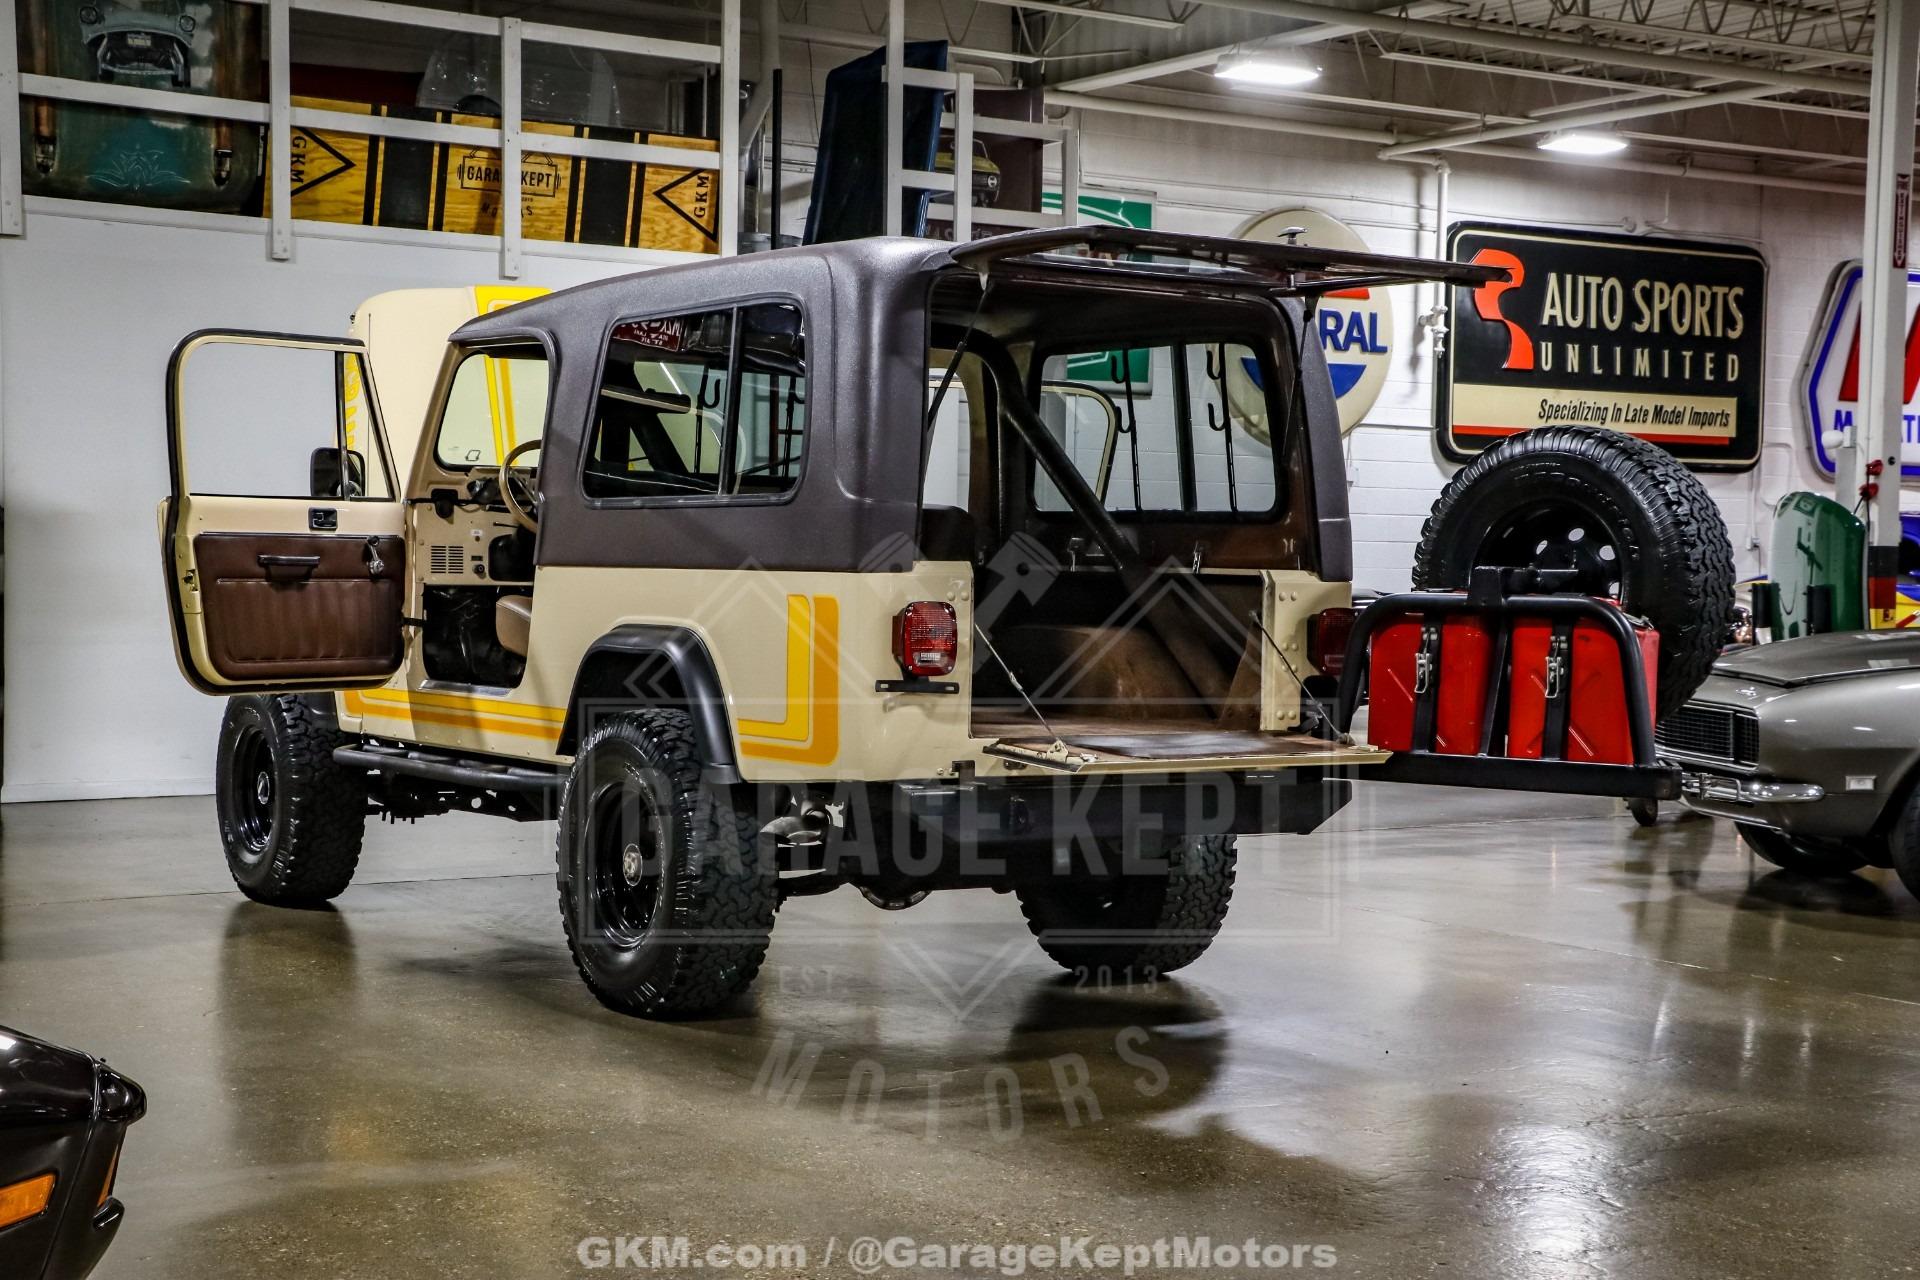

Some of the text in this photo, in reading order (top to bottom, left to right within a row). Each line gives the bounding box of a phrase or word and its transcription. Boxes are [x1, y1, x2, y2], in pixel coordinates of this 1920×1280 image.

[291, 135, 307, 184] GKM
[467, 165, 552, 188] GARA KEPT
[693, 175, 709, 218] GKM
[1541, 272, 1744, 339] AUTO SPORTS
[1539, 341, 1739, 382] UNLIMITED
[1538, 399, 1731, 430] Specializing In Late Model Imports
